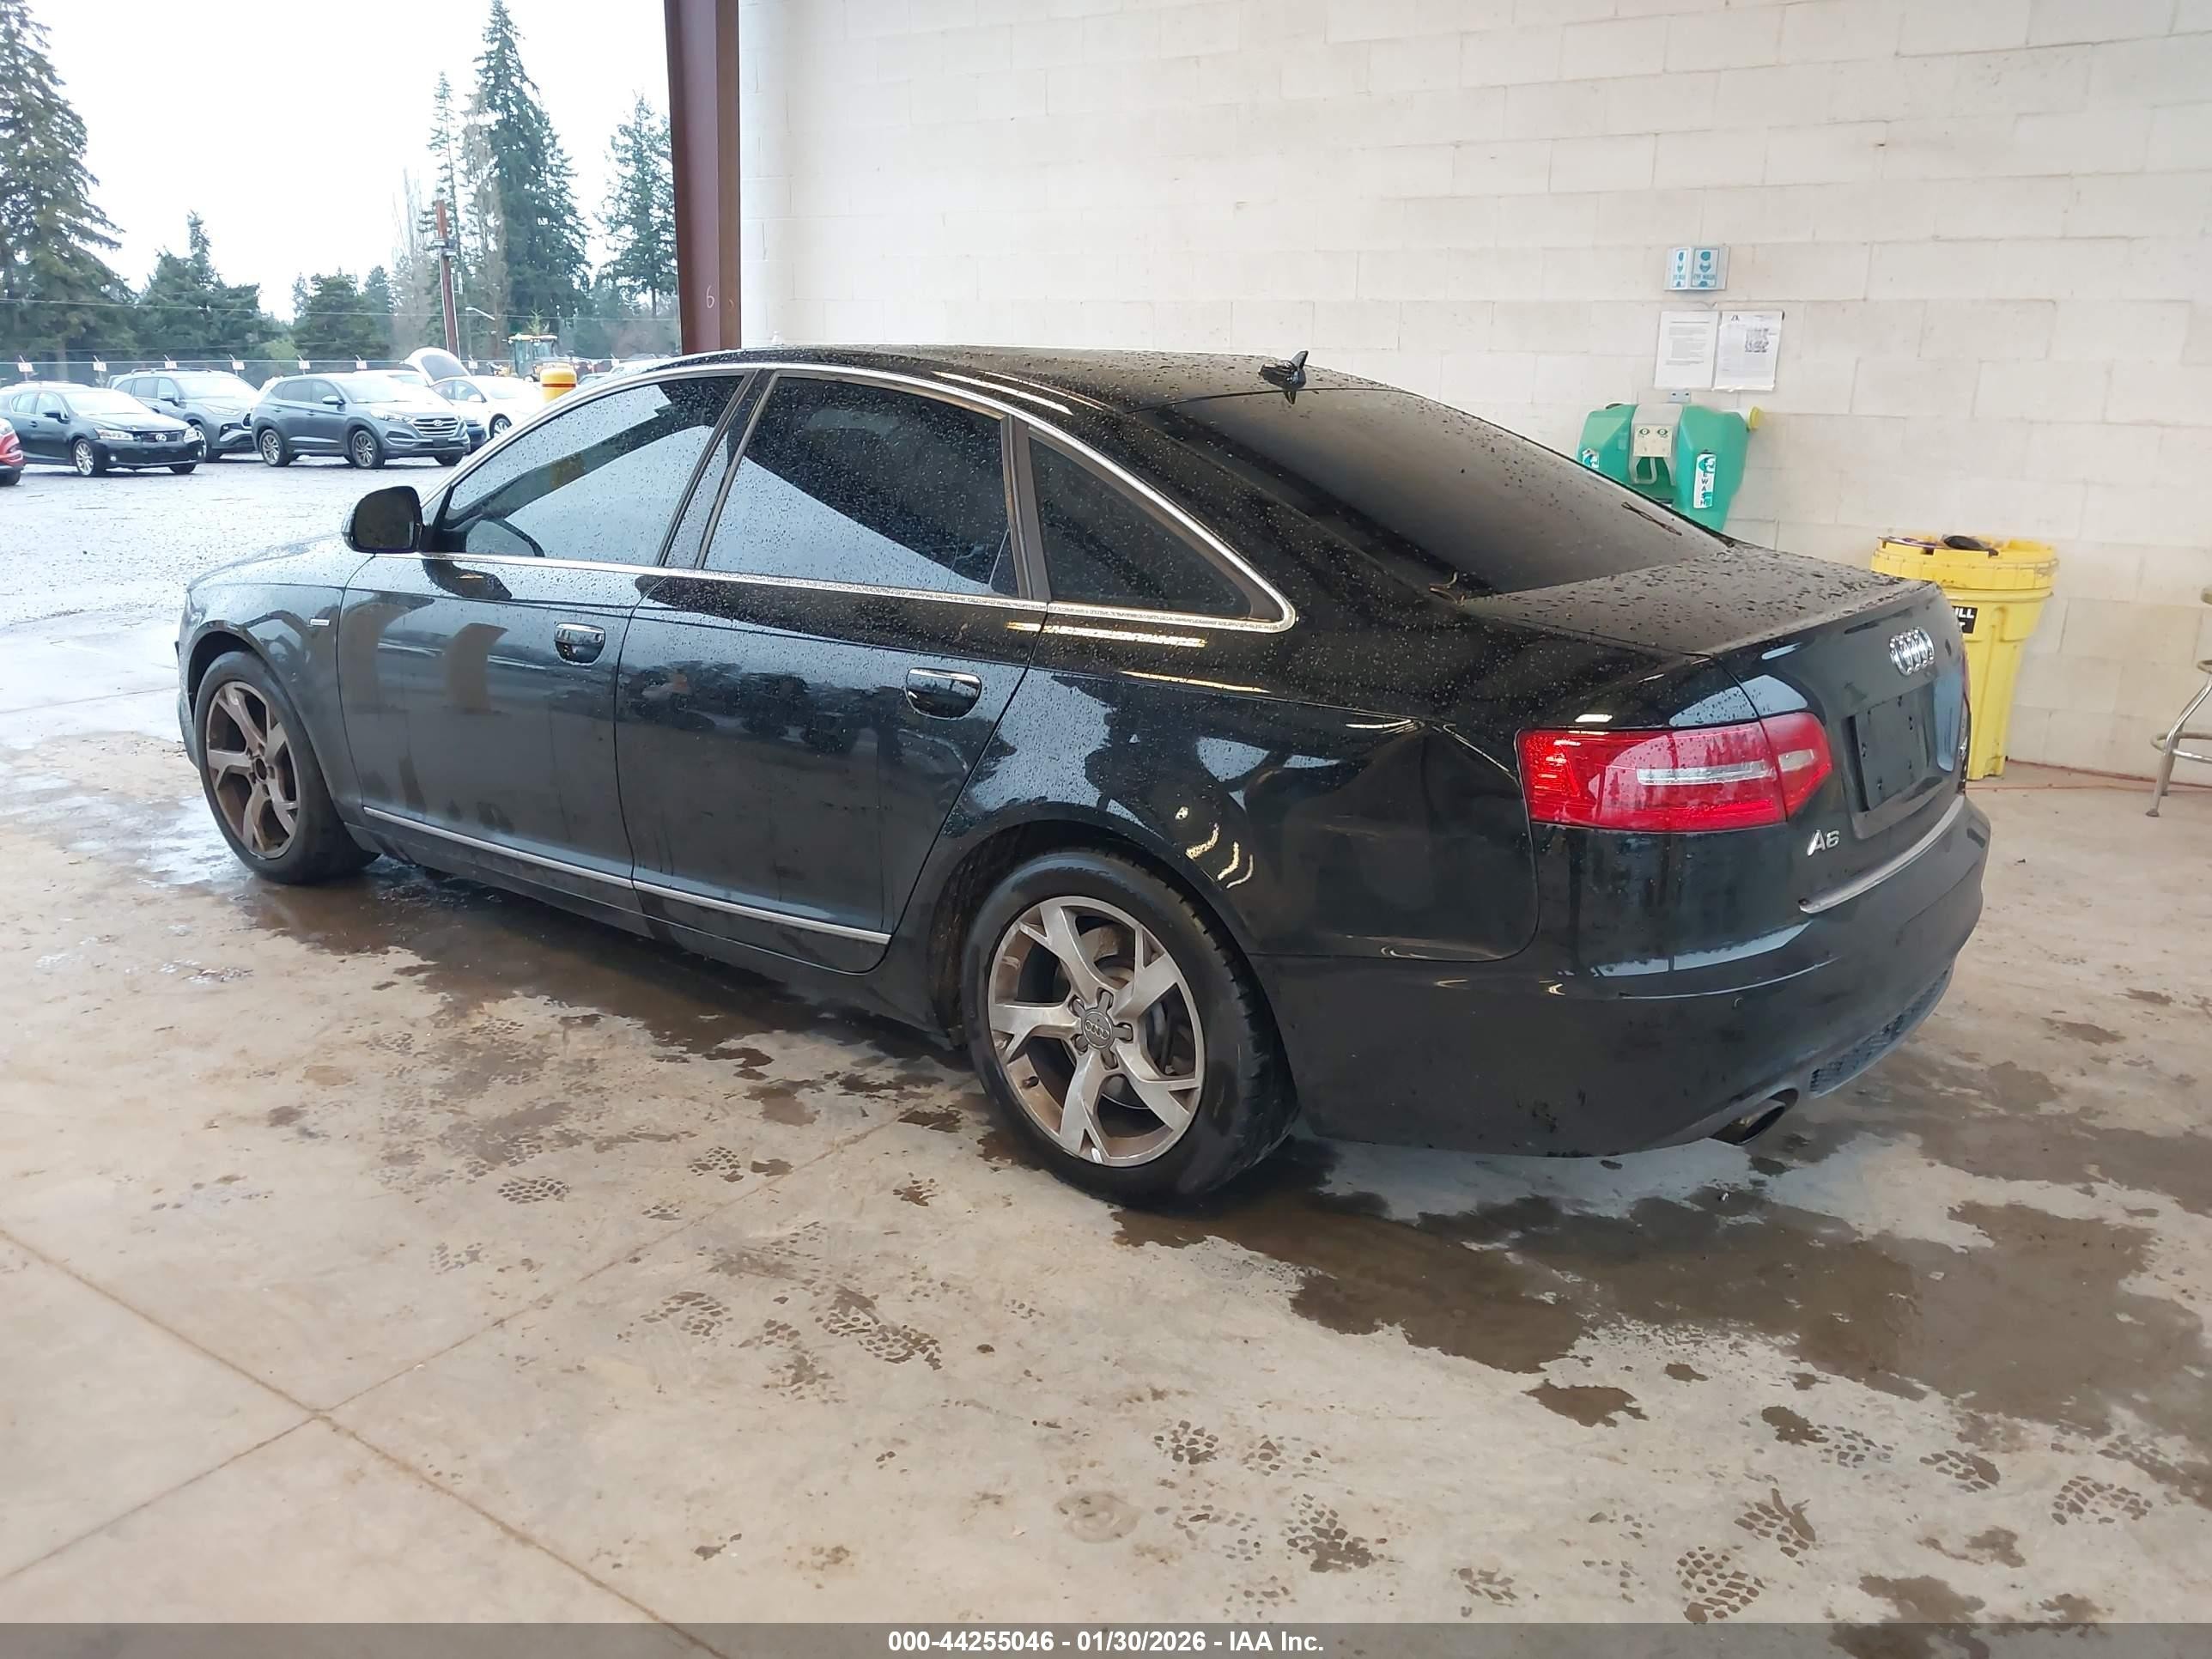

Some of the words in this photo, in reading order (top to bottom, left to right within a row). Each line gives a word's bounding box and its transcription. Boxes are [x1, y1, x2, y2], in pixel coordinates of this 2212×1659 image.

[706, 284, 715, 309] 6
[1954, 606, 1975, 619] ILL
[1807, 830, 1839, 856] A6
